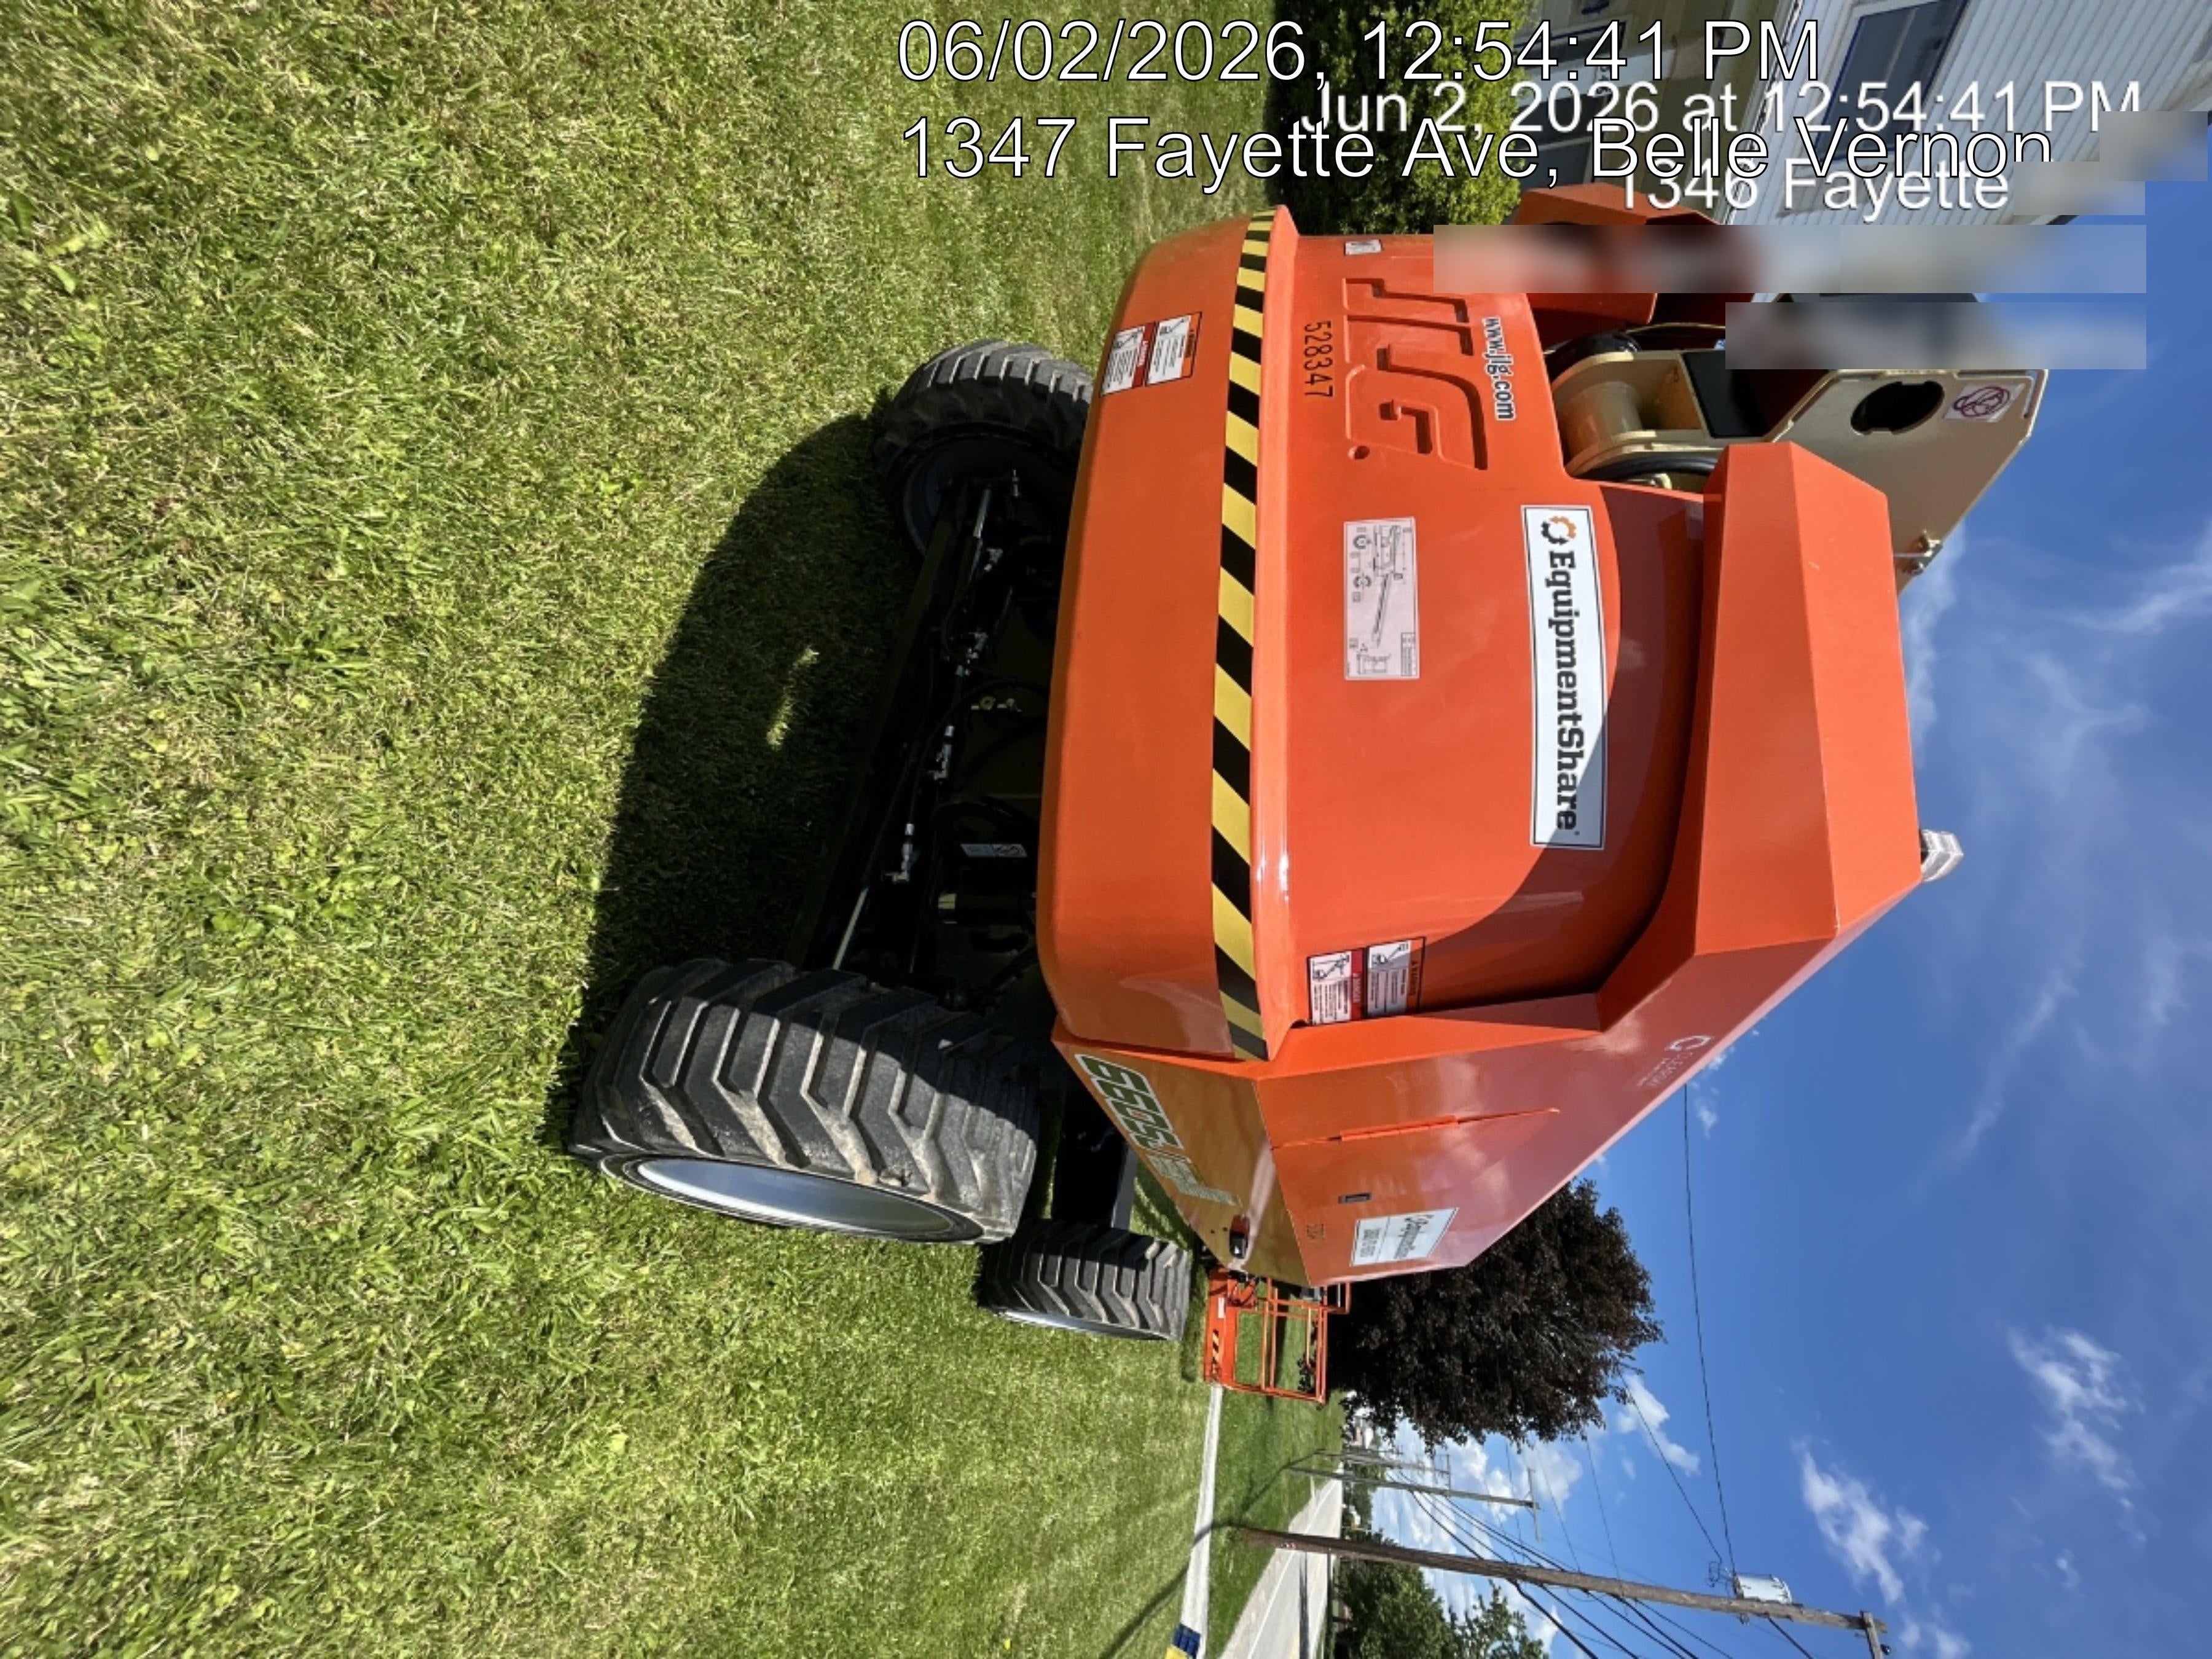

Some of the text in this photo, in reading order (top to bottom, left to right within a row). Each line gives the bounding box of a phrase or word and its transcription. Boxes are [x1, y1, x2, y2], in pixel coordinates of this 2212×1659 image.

[1304, 320, 1333, 397] 528347
[1483, 317, 1515, 420] www.jlg.com
[1545, 550, 1585, 831] EquipmentShare
